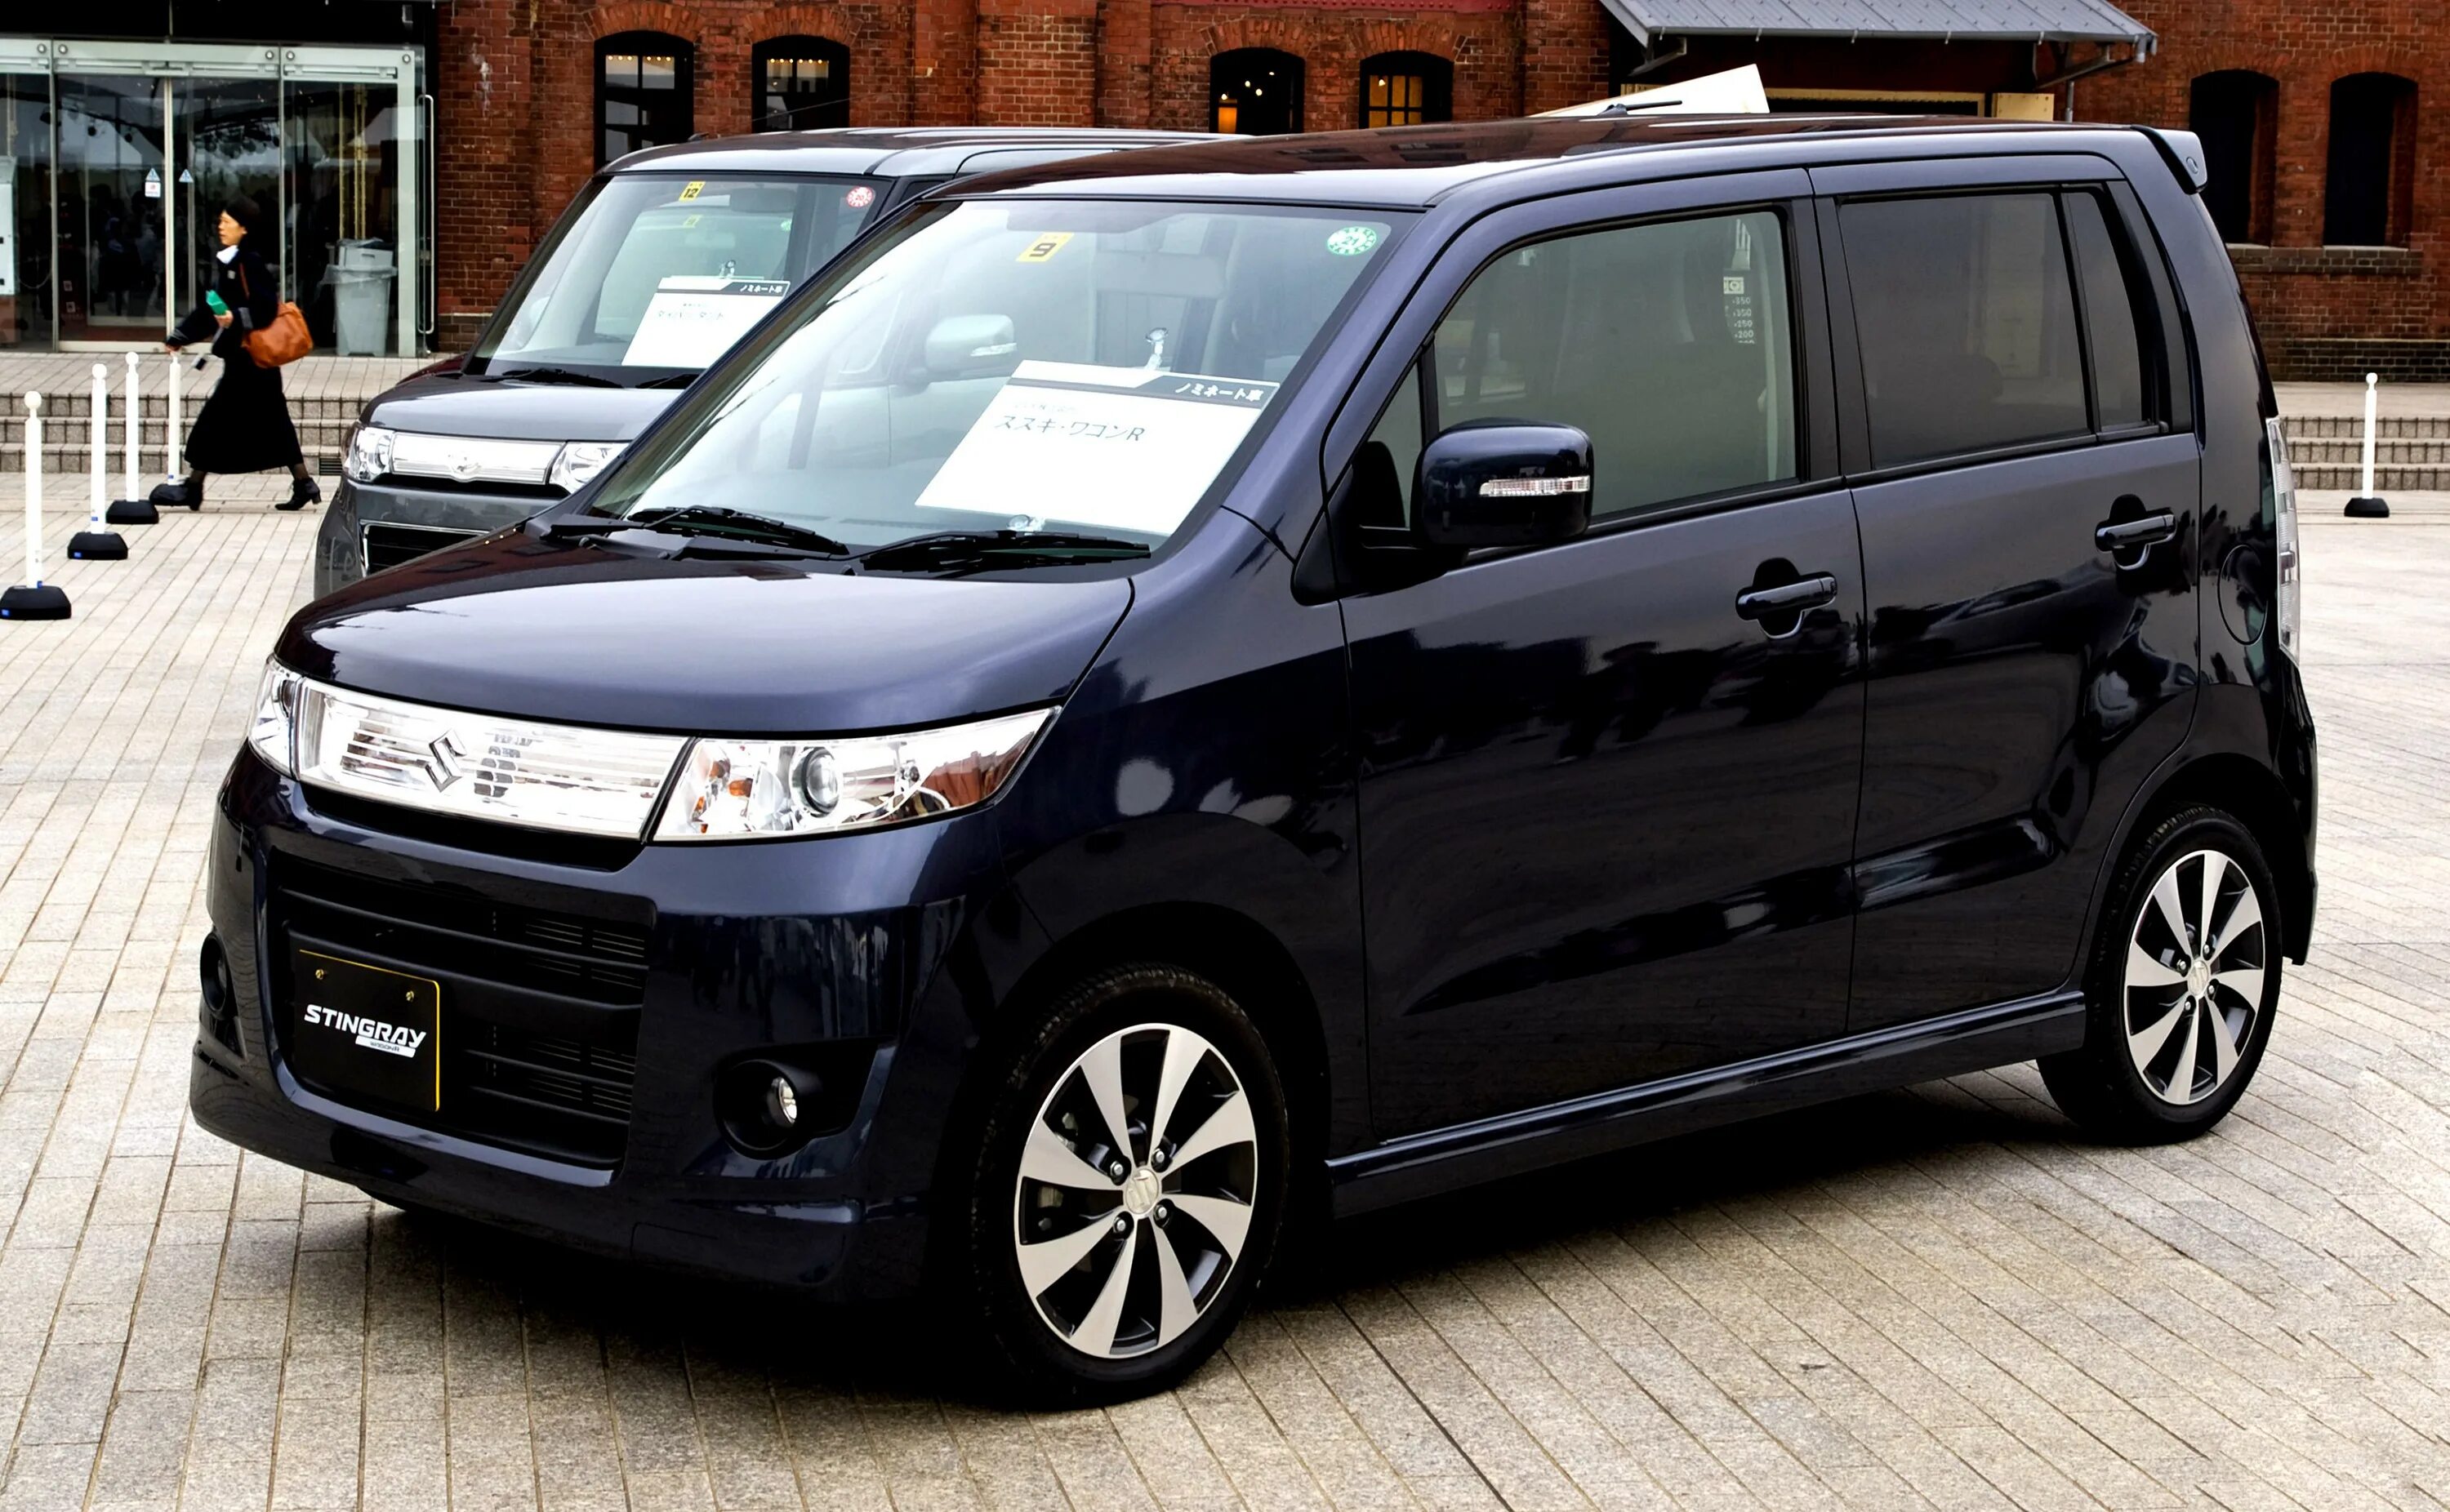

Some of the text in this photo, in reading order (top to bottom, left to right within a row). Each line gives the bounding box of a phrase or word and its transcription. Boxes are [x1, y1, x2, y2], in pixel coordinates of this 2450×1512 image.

[684, 188, 699, 198] 12
[1029, 242, 1057, 257] 9
[304, 1003, 427, 1049] STINGRAY
